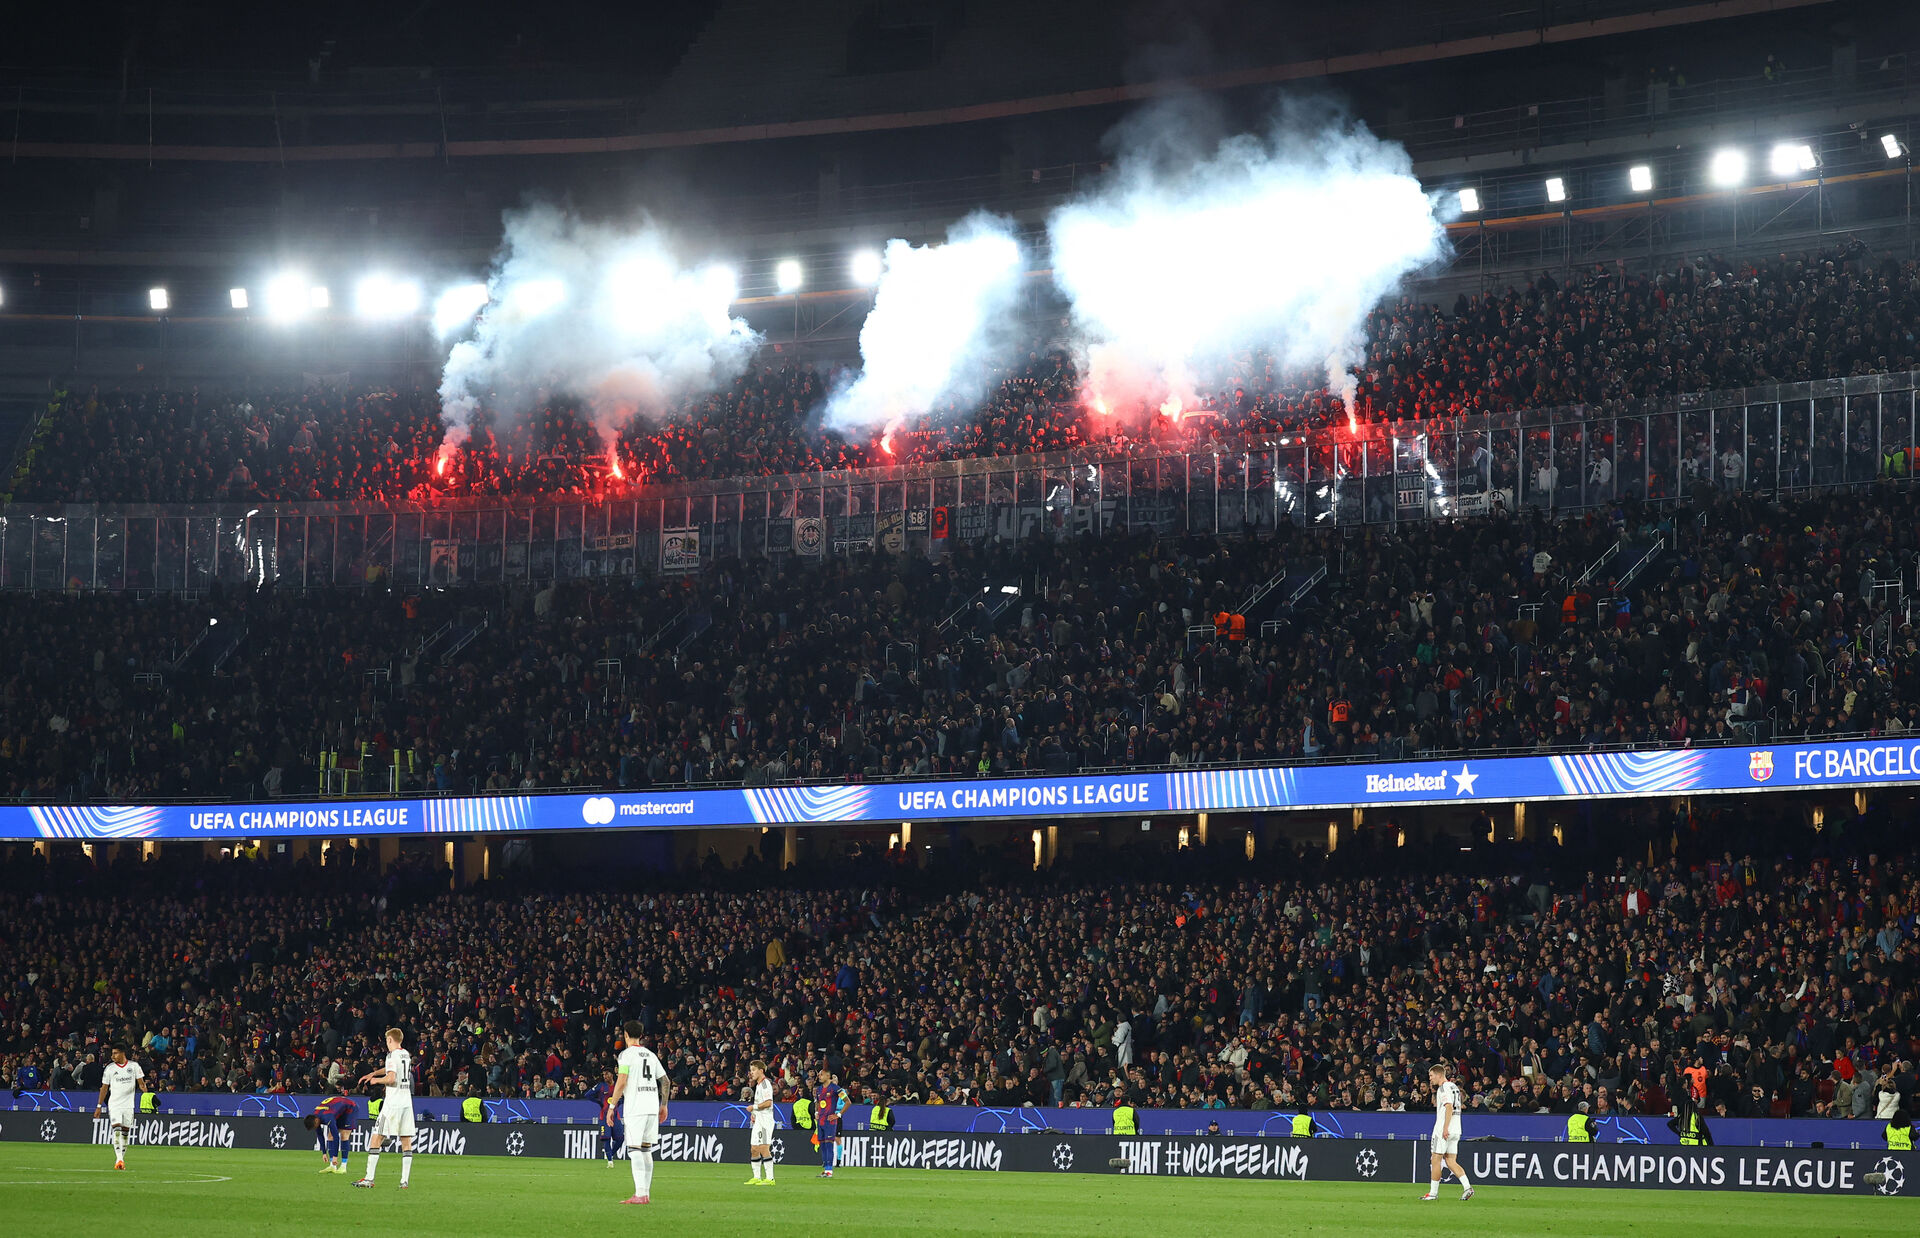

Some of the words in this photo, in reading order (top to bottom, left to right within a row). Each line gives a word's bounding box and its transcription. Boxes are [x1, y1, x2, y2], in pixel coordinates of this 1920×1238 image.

[1795, 749, 1822, 779] FC
[1366, 770, 1447, 793] Heineken
[619, 800, 694, 817] mastercard
[899, 791, 947, 811] UEFA
[952, 786, 1068, 808] CHAMPIONS
[1073, 782, 1150, 805] LEAGUE
[190, 812, 235, 830] UEFA
[240, 810, 339, 829] CHAMPIONS
[344, 807, 409, 827] LEAGUE
[642, 1058, 652, 1081] 4
[92, 1117, 115, 1144] THA
[563, 1129, 599, 1160] THAT
[870, 1136, 1003, 1172] #UCLFEELING
[1165, 1141, 1309, 1181] #UCLFEELING
[1473, 1152, 1544, 1180] UEFA
[1553, 1153, 1726, 1185] CHAMPIONS
[1738, 1158, 1855, 1189] LEAGUE
